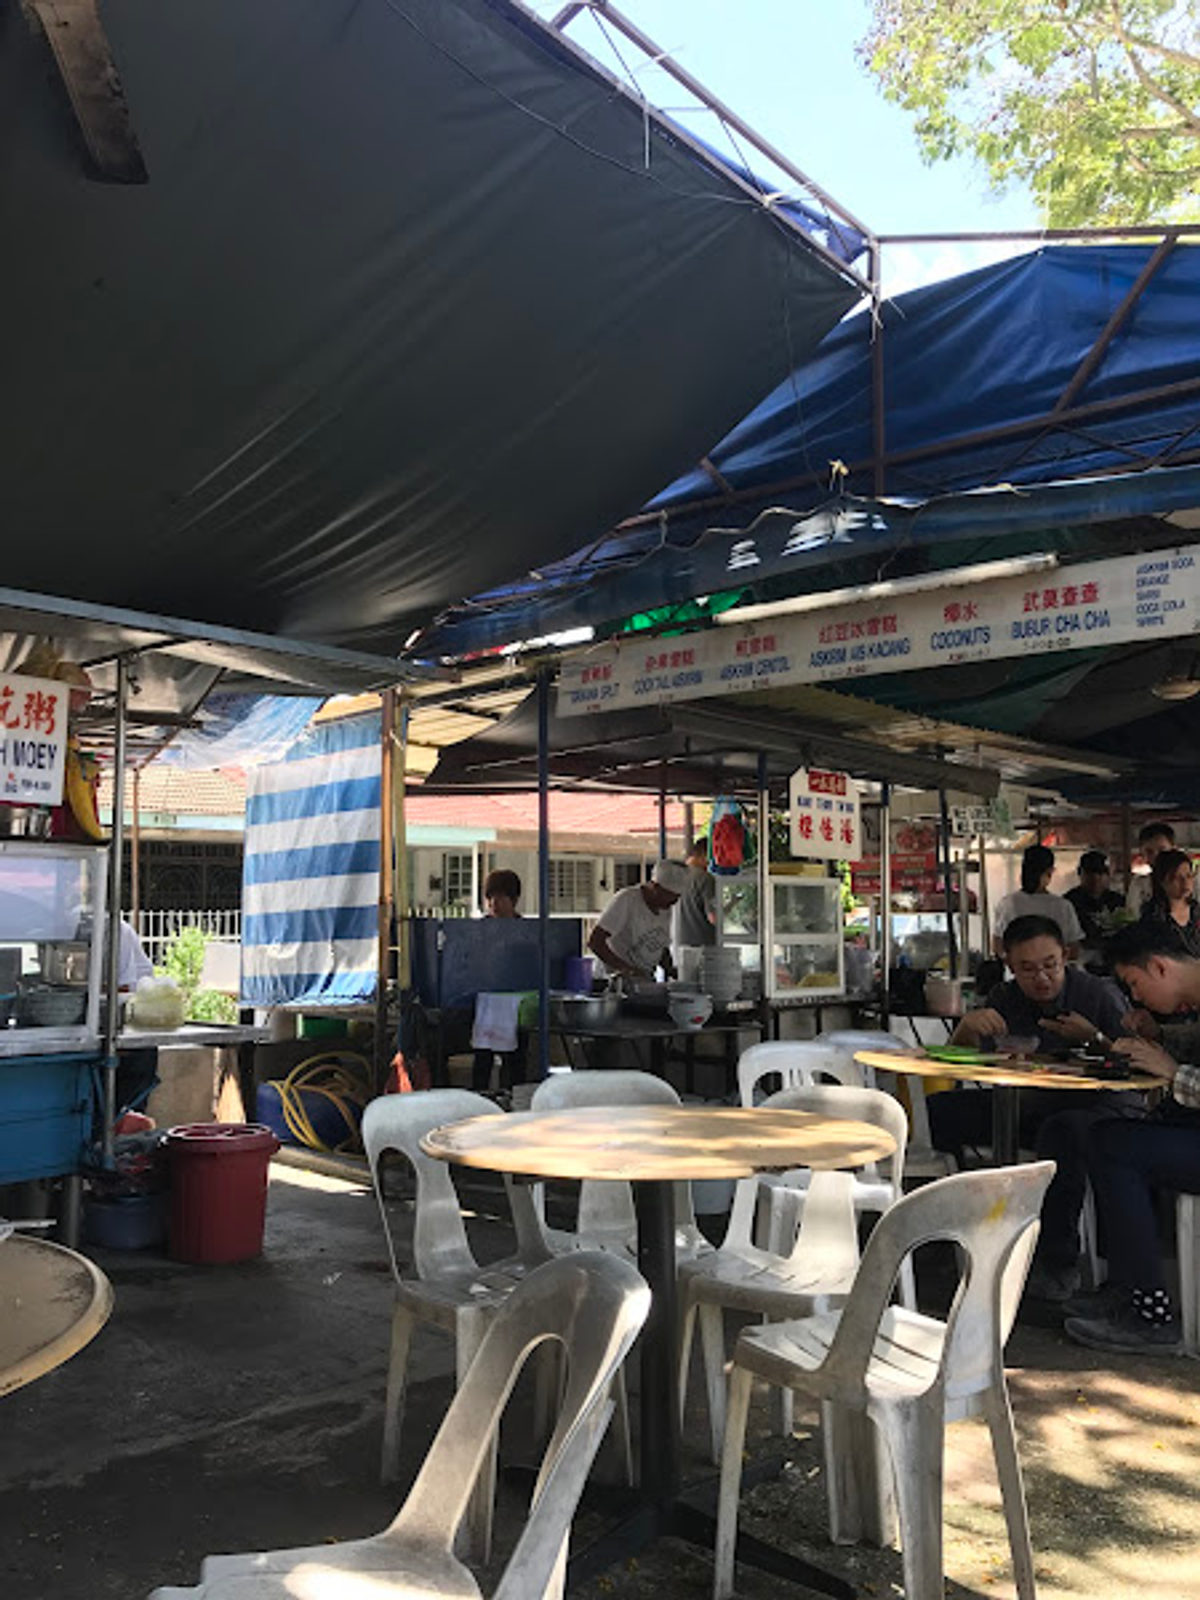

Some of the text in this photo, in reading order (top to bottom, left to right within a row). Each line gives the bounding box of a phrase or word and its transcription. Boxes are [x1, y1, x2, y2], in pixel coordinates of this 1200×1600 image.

[1055, 613, 1082, 634] CHA
[1084, 608, 1111, 631] CHA
[930, 624, 991, 651] COCONUTS
[13, 739, 57, 770] MOEY
